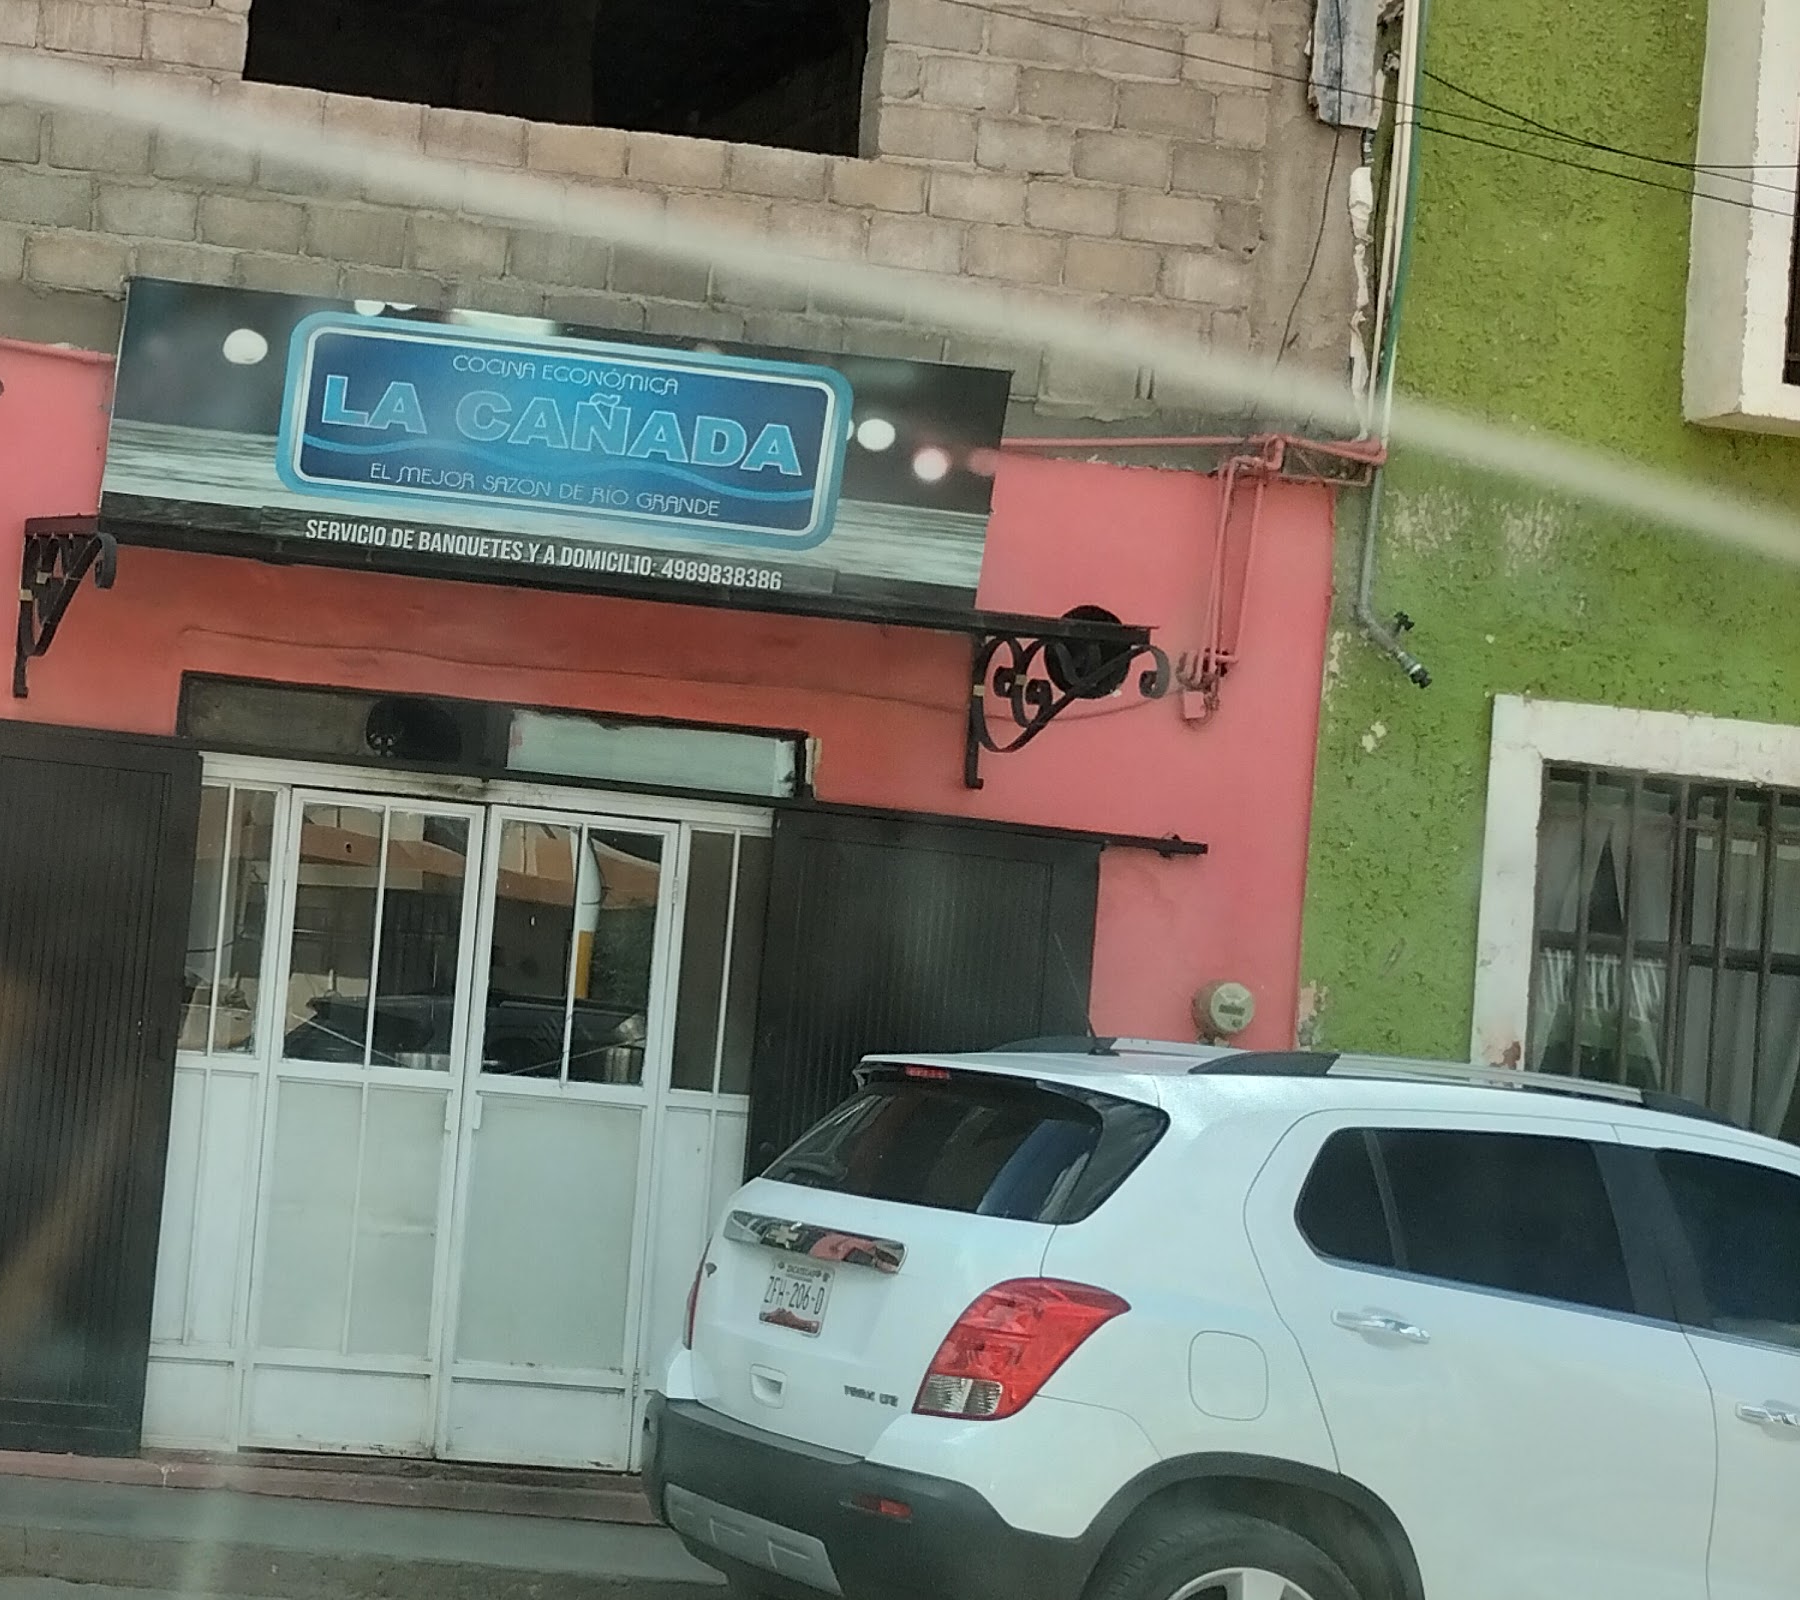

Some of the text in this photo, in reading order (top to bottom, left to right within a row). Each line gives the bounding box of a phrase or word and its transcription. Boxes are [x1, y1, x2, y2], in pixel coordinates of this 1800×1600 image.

[452, 354, 679, 396] COCINA ECONÓMICA
[320, 374, 802, 477] LA CAÑADA
[369, 462, 391, 481] EL
[395, 465, 475, 490] MEJOR
[559, 483, 585, 501] DE
[635, 491, 721, 517] GRANDE
[305, 518, 783, 591] SERVICIO DE BANQUETES Y A DOMICILIO: 4989838386
